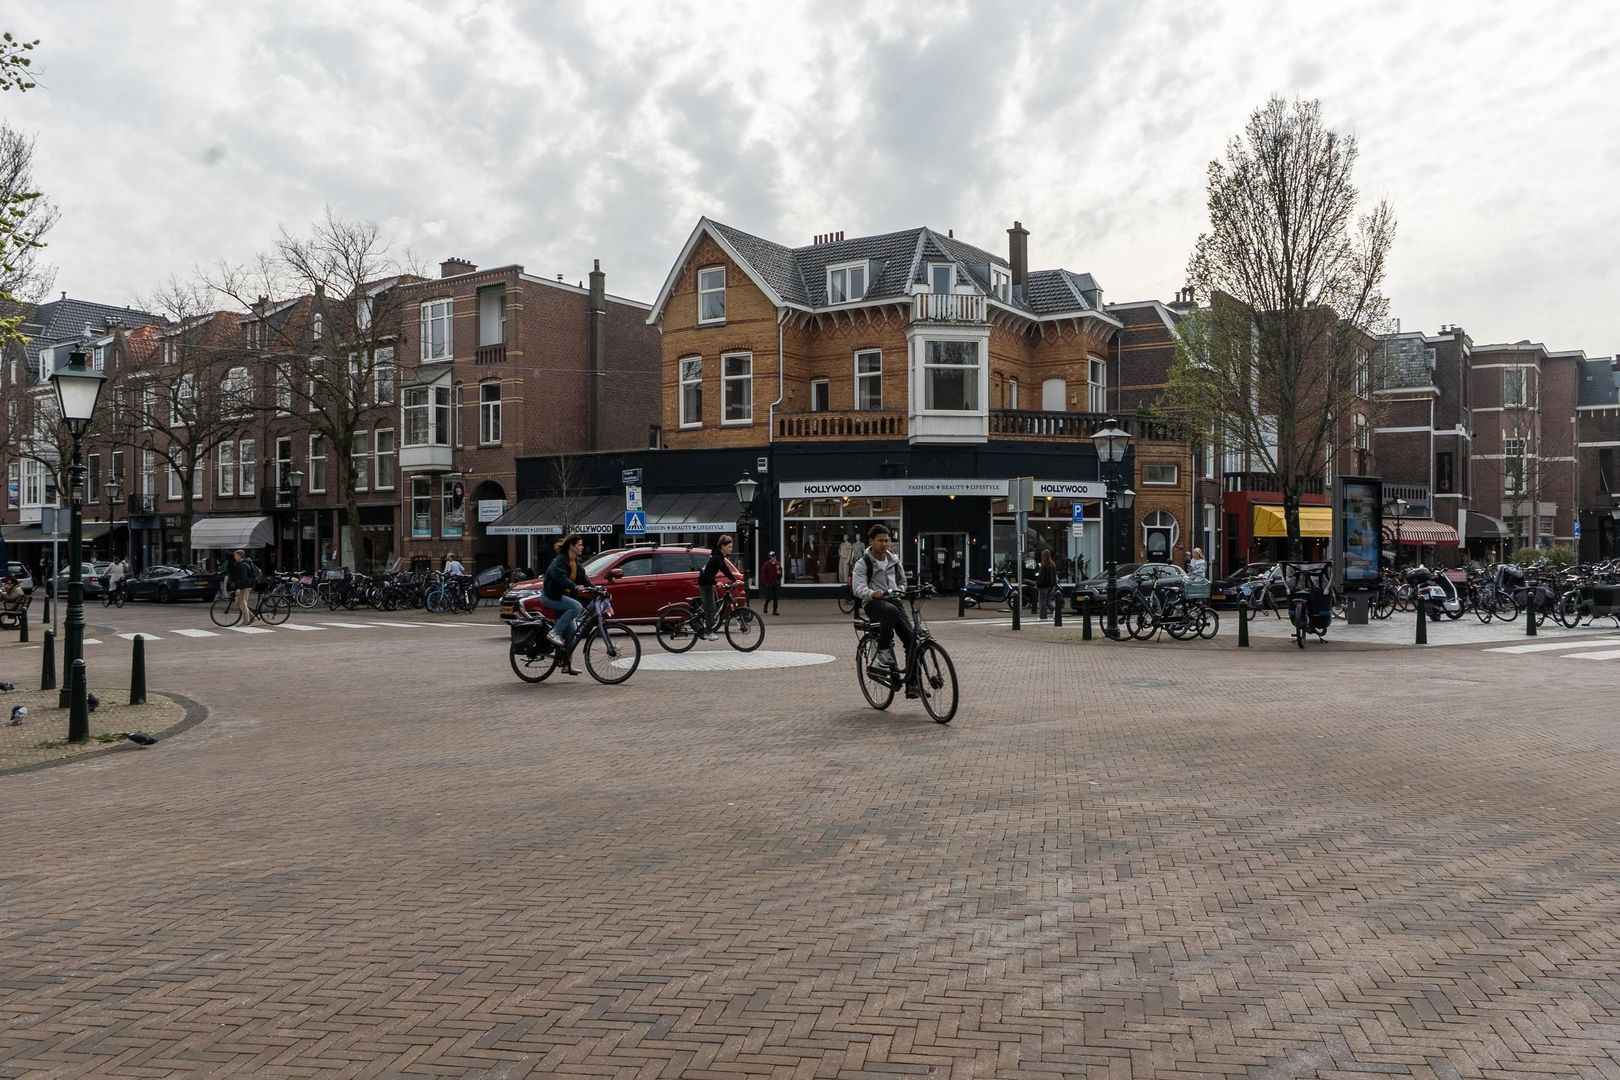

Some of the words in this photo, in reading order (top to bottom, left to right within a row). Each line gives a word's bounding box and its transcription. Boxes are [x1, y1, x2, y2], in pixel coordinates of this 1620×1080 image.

[804, 484, 862, 494] HOLLYWOOD
[1040, 484, 1089, 494] HOLLYWOOD
[1074, 505, 1082, 517] P
